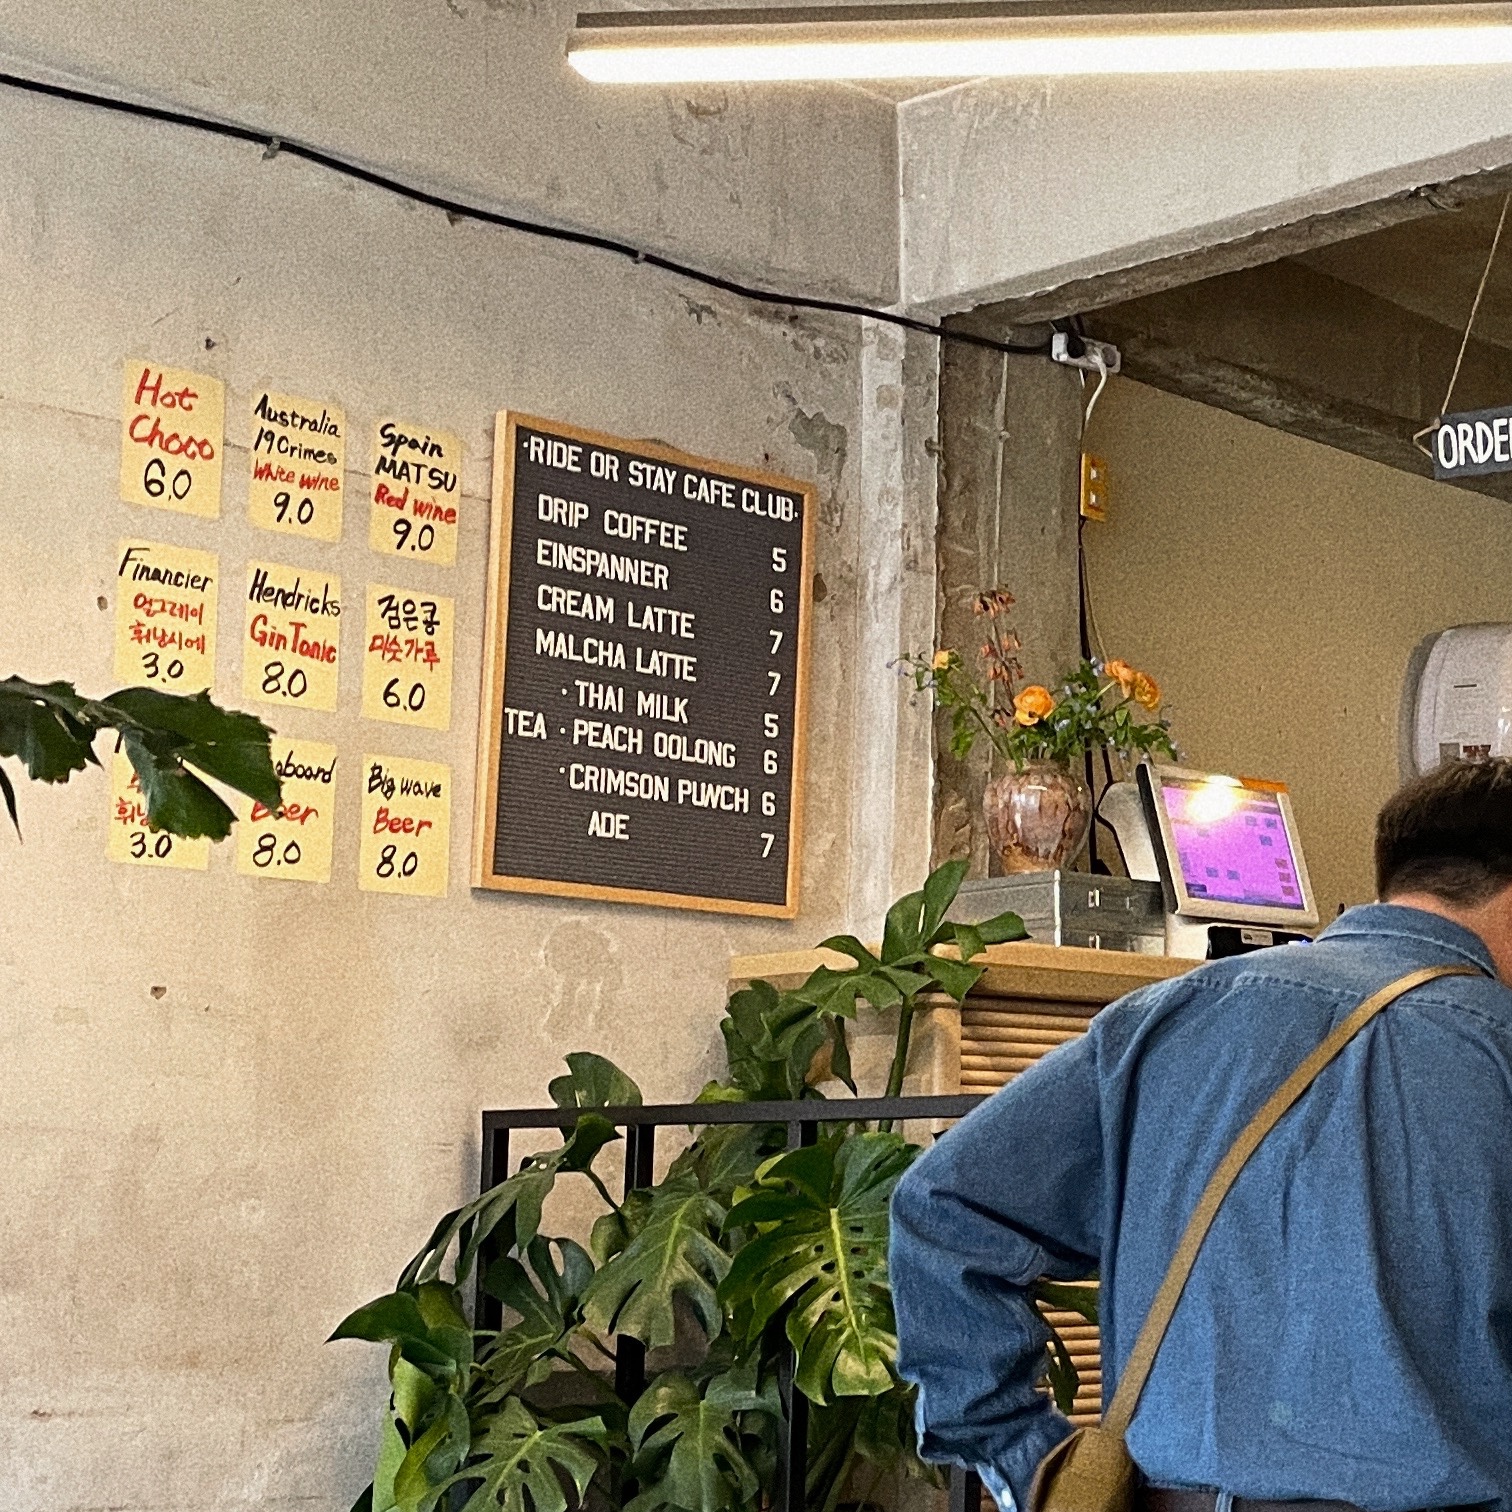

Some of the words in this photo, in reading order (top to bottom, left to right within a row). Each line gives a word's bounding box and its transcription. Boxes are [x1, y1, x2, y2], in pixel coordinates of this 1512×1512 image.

[135, 368, 198, 411] Hot
[254, 393, 341, 438] Australia
[129, 414, 214, 461] Choco
[380, 423, 443, 457] Spain
[144, 458, 192, 501] 6.0
[375, 455, 456, 492] MATSU
[530, 436, 583, 473] RIDE
[590, 450, 619, 482] OR
[628, 460, 677, 495] STAY
[683, 474, 736, 509] CAFE
[741, 488, 794, 523] CLUB
[274, 492, 314, 524] 9.0
[375, 483, 409, 511] Red
[413, 496, 456, 525] wine
[393, 518, 435, 551] 9.0
[538, 493, 589, 529] DRIP
[603, 509, 688, 551] COFFEE
[772, 547, 787, 573] 5
[119, 547, 213, 592] Financier
[537, 538, 669, 590] EINSPANNER
[769, 589, 784, 614] 6
[133, 593, 204, 625] 얼그레이
[249, 568, 341, 617] Hendricks
[377, 594, 440, 636] 검은콩
[537, 584, 614, 624] CREAM
[628, 601, 695, 639] LATTE
[769, 629, 783, 655] 7
[142, 652, 184, 683] 3.0
[262, 661, 307, 697] 8.0
[535, 628, 626, 670] MALCHA
[636, 647, 697, 682] LATTE
[768, 671, 781, 696] 7
[383, 677, 426, 712] 6.0
[574, 679, 624, 713] THAI
[637, 690, 688, 724] MILK
[764, 713, 779, 738] 5
[504, 707, 547, 740] TEA
[573, 718, 643, 755] PEACH
[654, 732, 736, 769] OOLONG
[763, 749, 777, 775] 6
[368, 762, 395, 801] Big
[569, 763, 669, 801] CRIMSON
[678, 779, 749, 813] PUNCH
[761, 792, 776, 816] 6
[373, 806, 432, 837] Beer
[588, 810, 630, 840] ADE
[760, 833, 775, 858] 7
[130, 831, 172, 858] 3.0
[253, 832, 301, 868] 8.0
[376, 844, 418, 879] 8.0
